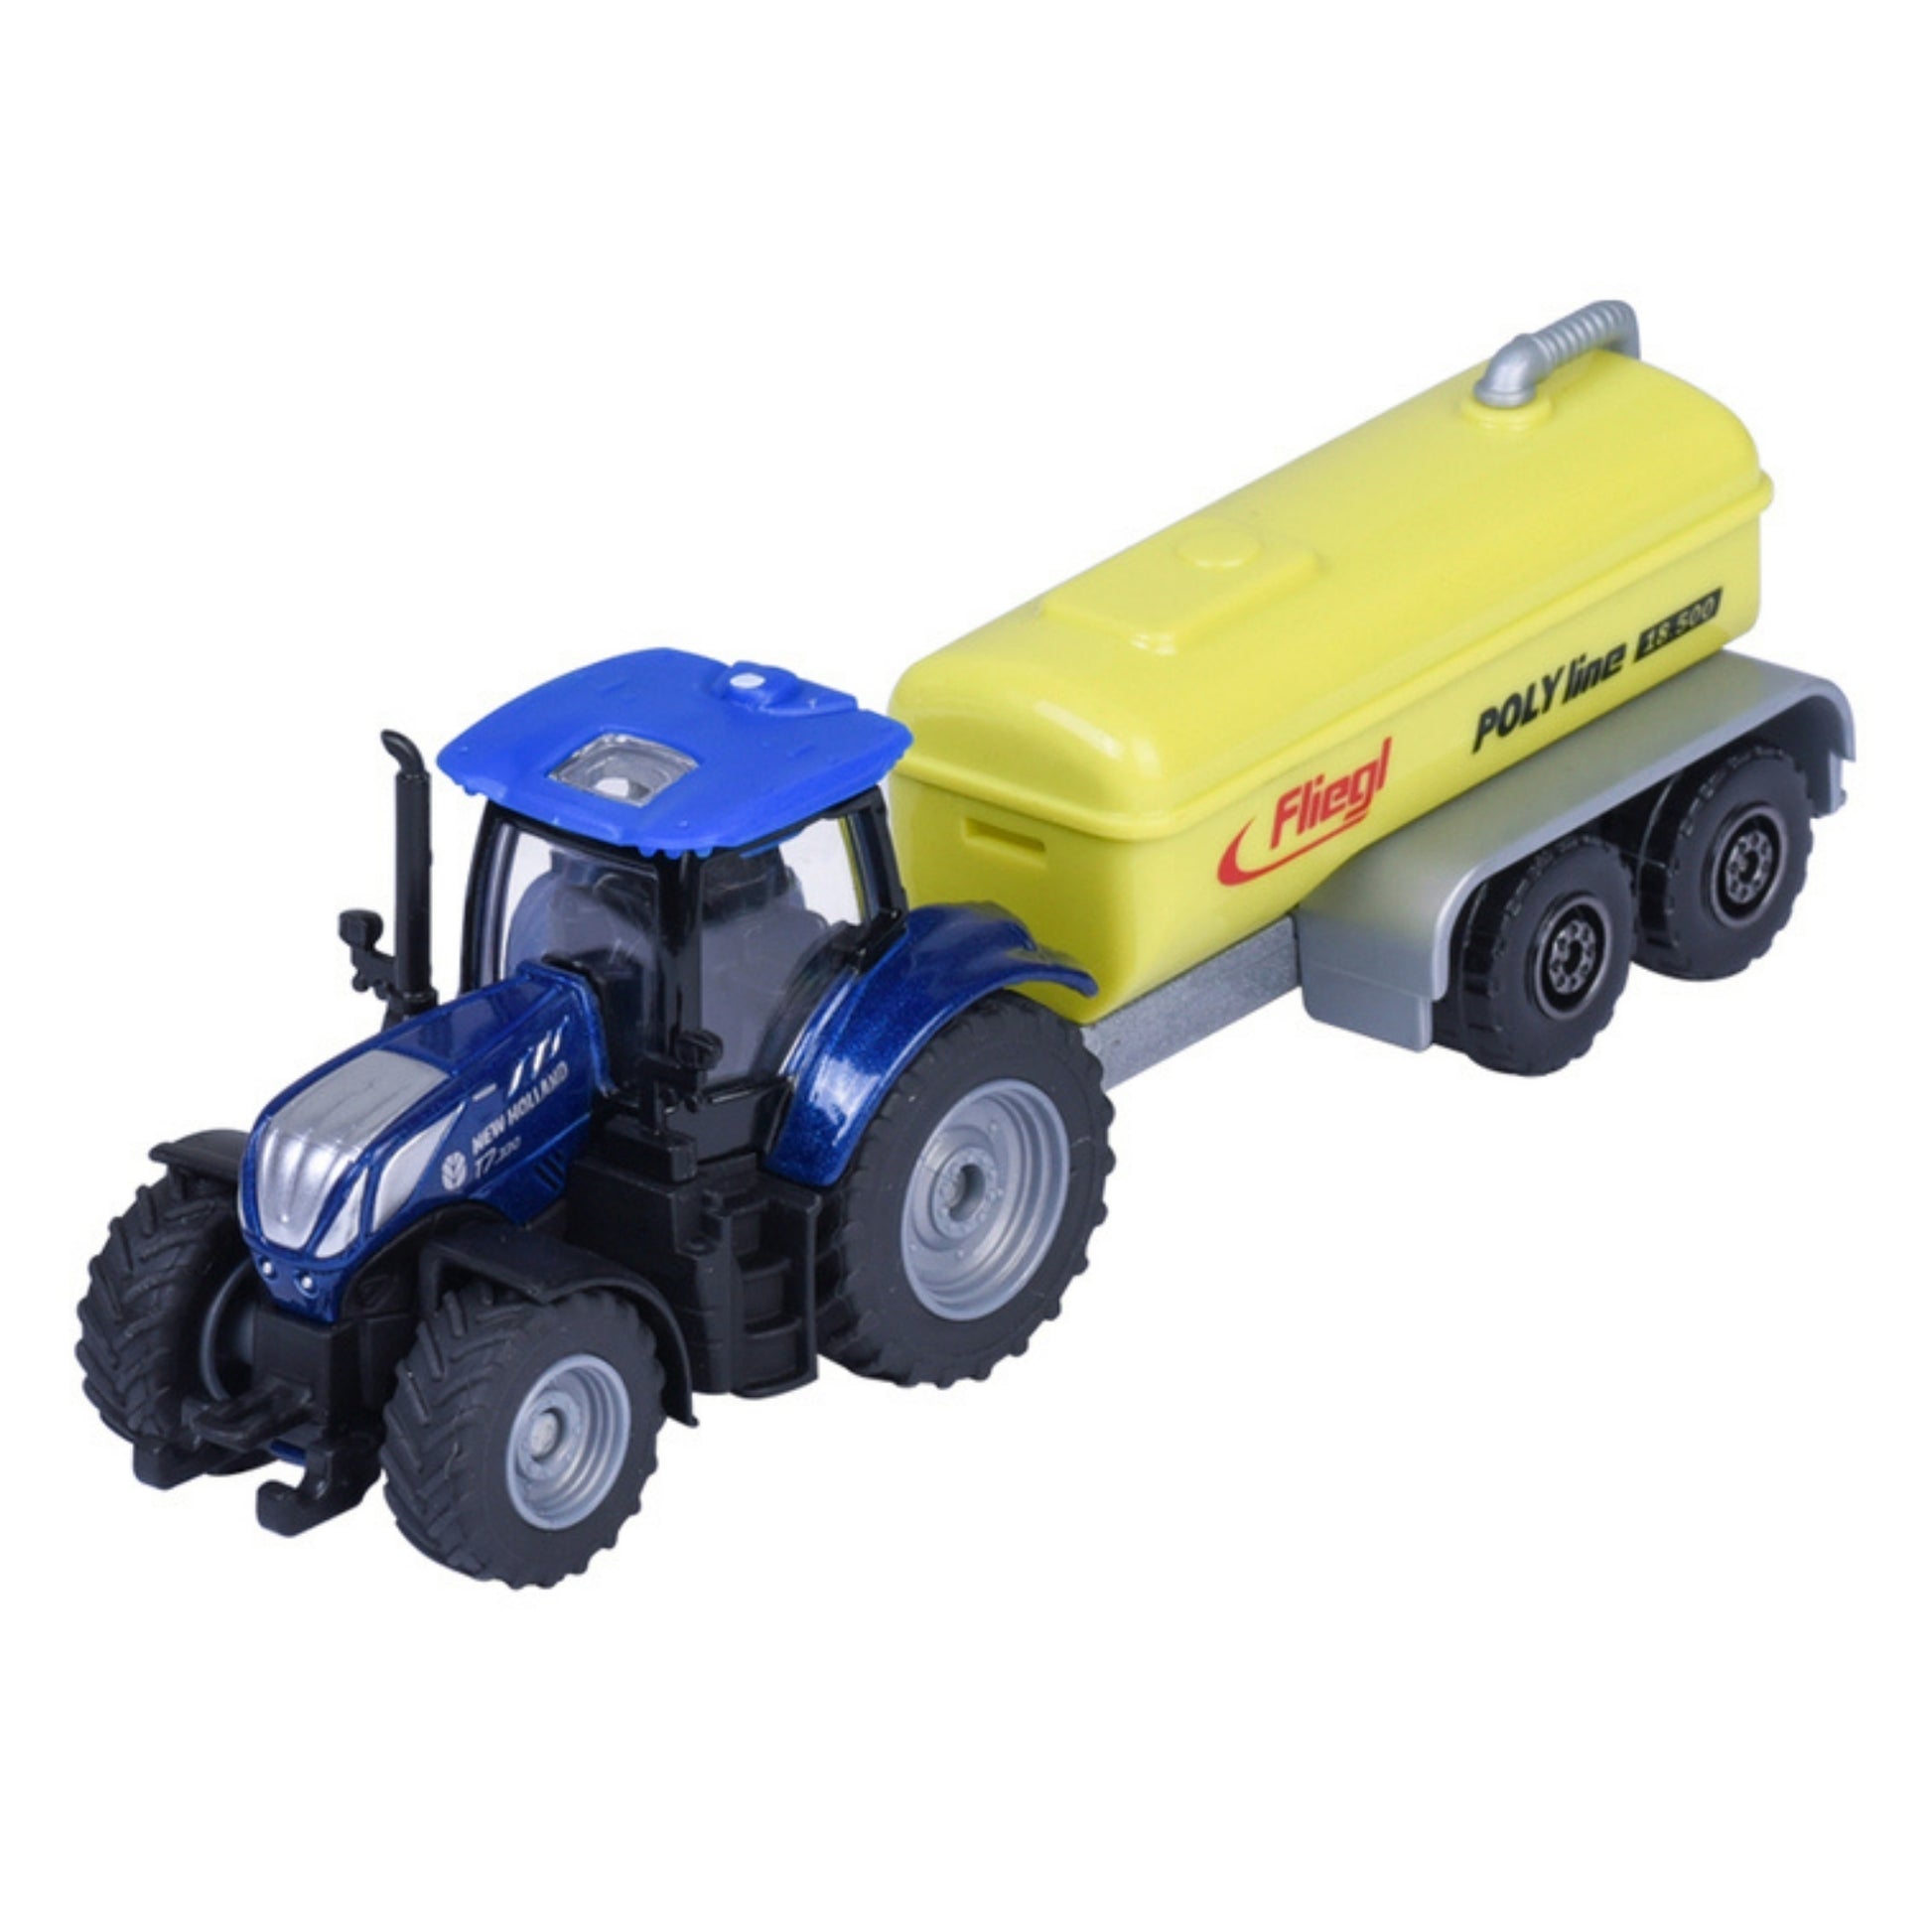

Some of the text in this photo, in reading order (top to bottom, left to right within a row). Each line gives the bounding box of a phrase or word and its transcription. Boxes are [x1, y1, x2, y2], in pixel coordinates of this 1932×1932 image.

[1269, 735, 1393, 851] Fliegl
[472, 1060, 569, 1156] NEW HOLLAND
